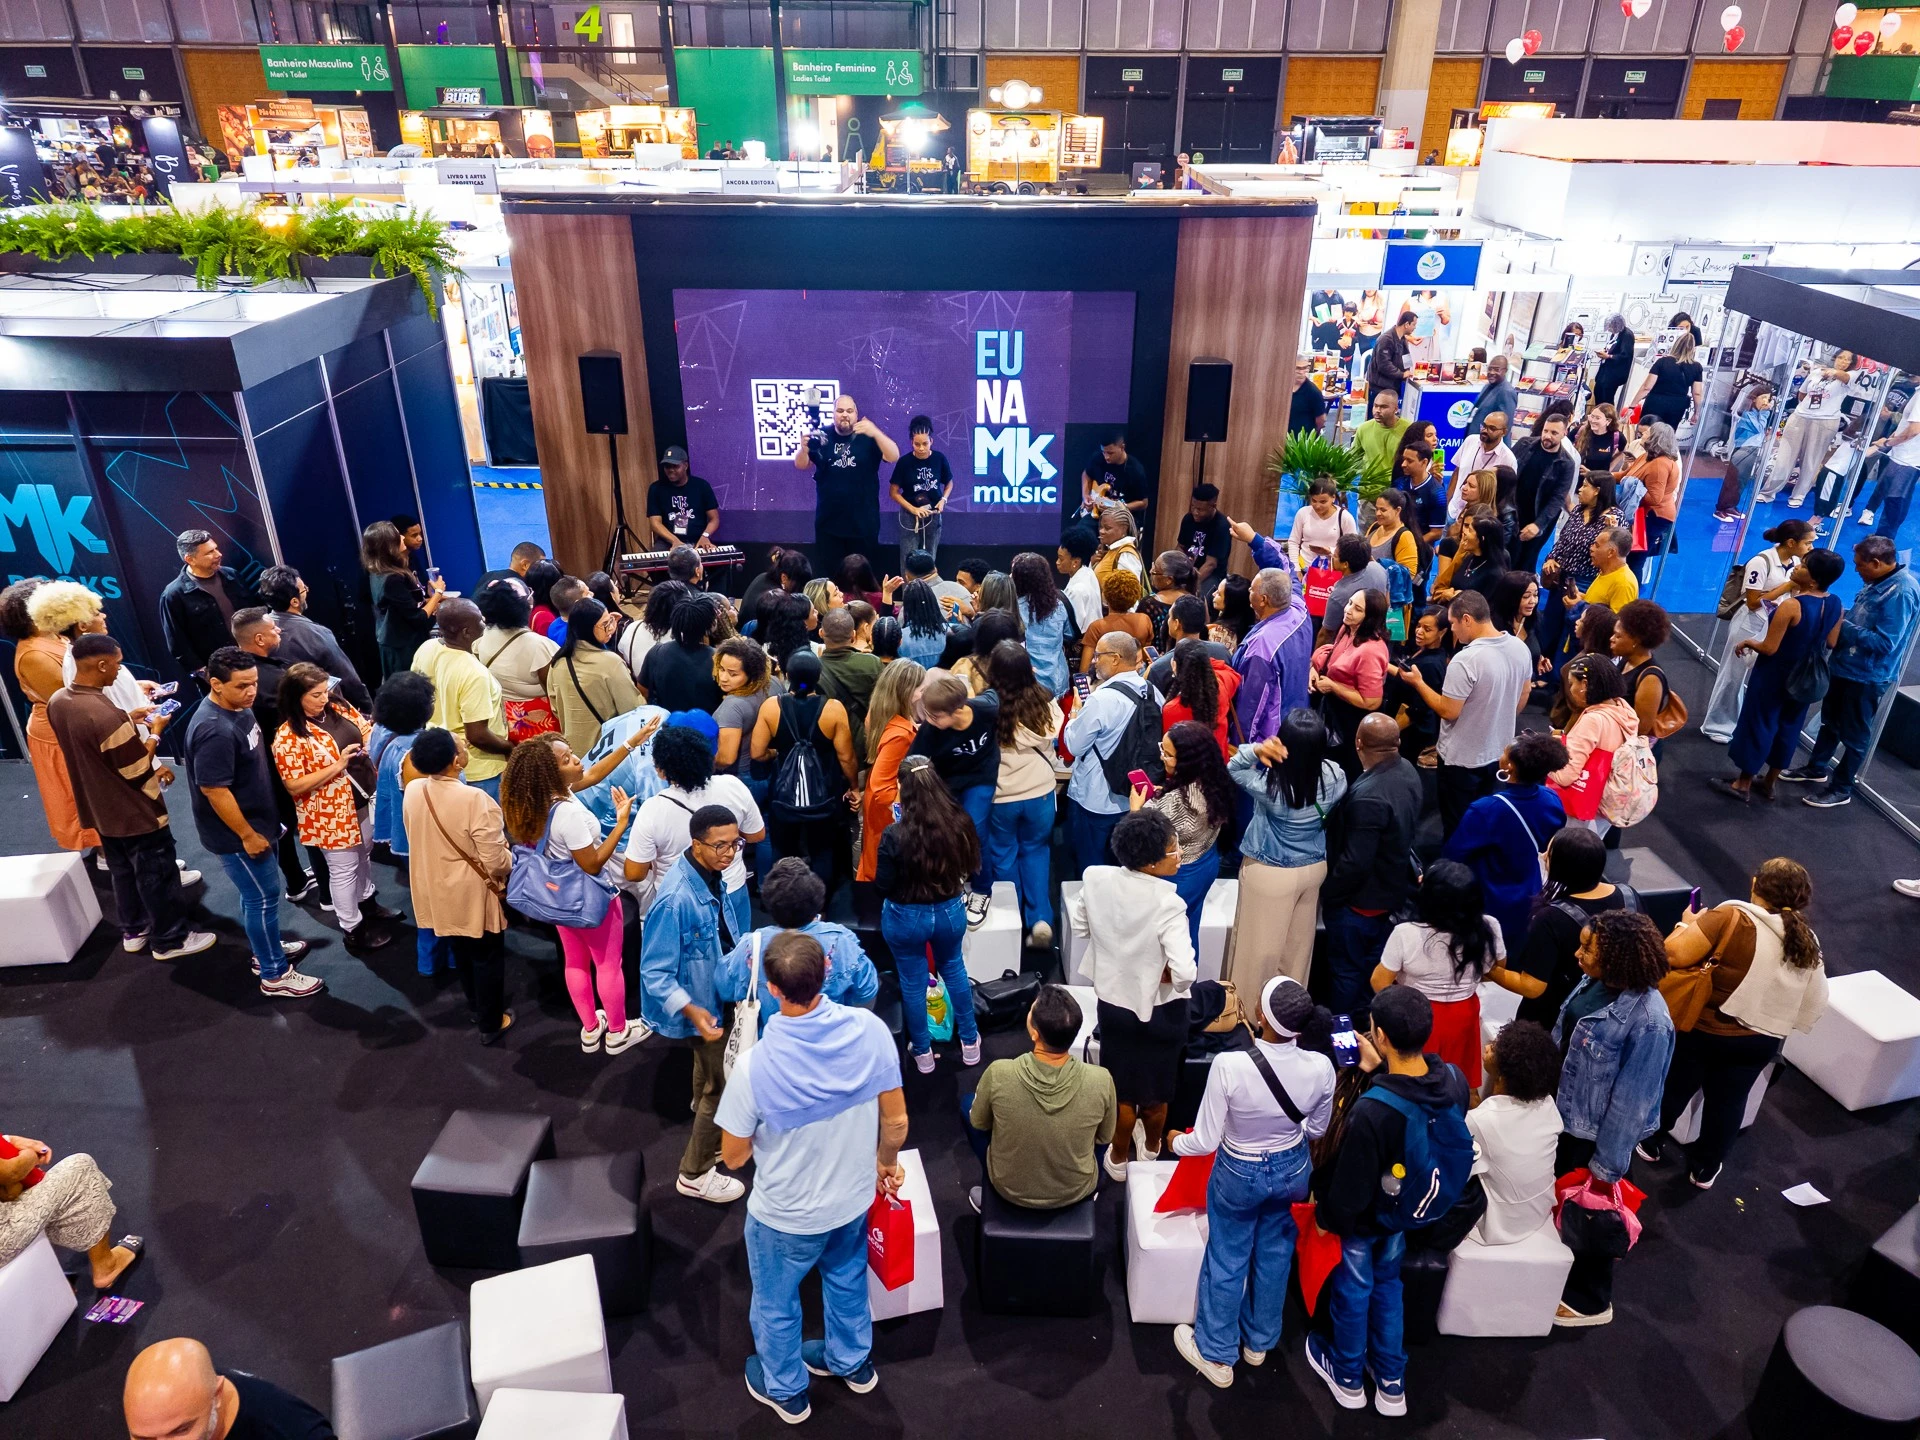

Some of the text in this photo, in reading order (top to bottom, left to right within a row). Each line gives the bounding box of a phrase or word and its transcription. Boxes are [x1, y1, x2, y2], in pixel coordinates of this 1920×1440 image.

[574, 4, 603, 42] 4
[267, 58, 353, 68] Banheiro Masculino
[792, 62, 876, 72] Banheiro Feminino
[976, 330, 1023, 376] EU
[976, 379, 1027, 424] NA
[974, 426, 1058, 487] MK
[1748, 571, 1759, 584] 3
